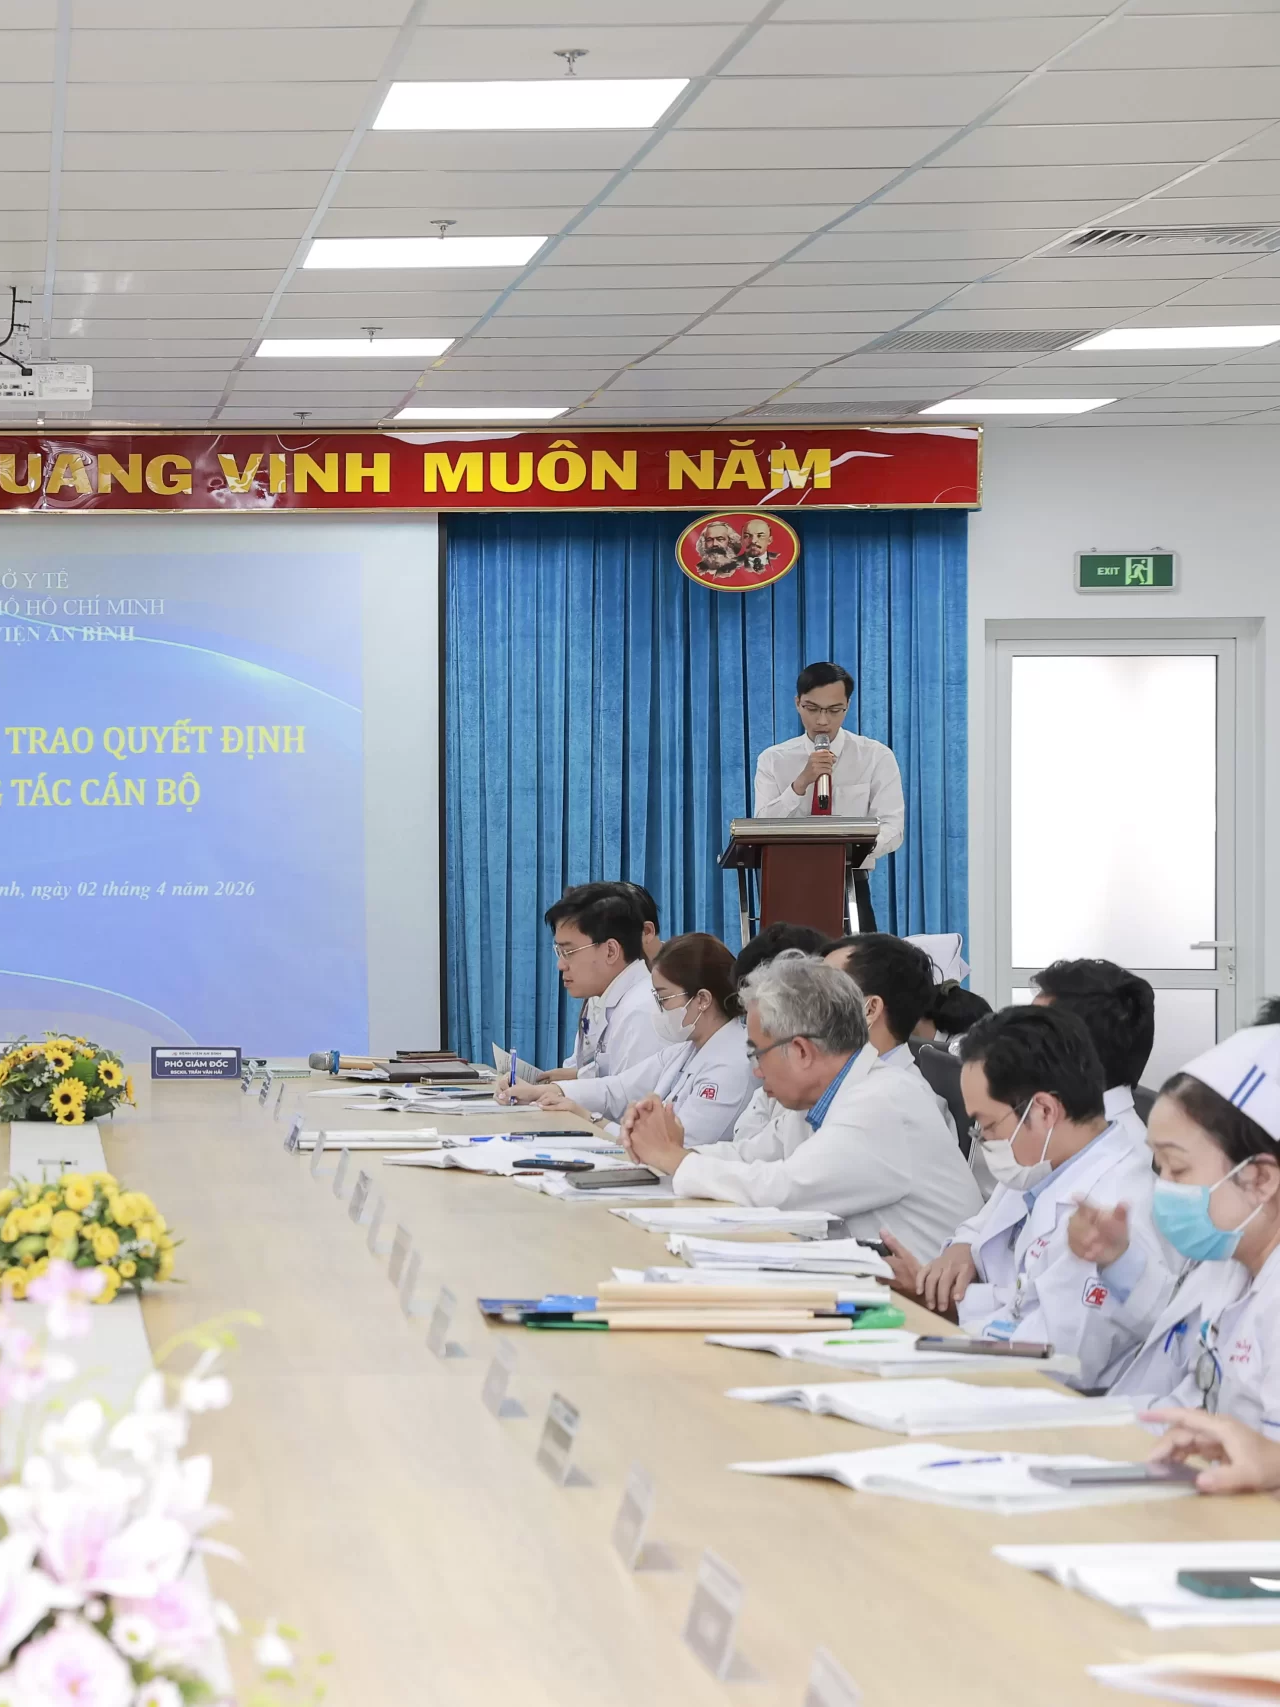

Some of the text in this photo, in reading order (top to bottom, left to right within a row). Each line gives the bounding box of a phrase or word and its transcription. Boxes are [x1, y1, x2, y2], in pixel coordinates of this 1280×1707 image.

[218, 453, 391, 494] VINH
[423, 439, 637, 493] MUÔN
[668, 439, 831, 490] NĂM
[22, 573, 38, 589] Y
[43, 568, 69, 589] TẾ
[1097, 567, 1120, 576] EXIT
[26, 595, 57, 616] HỒ
[63, 595, 100, 616] CHÍ
[106, 599, 165, 616] MINH
[45, 626, 75, 643] AN
[82, 621, 135, 642] BÌNH
[5, 726, 94, 754] TRAO
[103, 718, 213, 760] QUYẾT
[220, 725, 306, 760] ĐỊNH
[10, 772, 72, 806] TÁC
[80, 772, 147, 806] CÁN
[156, 771, 201, 812] BỘ
[31, 880, 72, 900] ngày
[77, 882, 97, 896] 02
[102, 881, 151, 900] tháng
[156, 881, 167, 896] 4
[171, 884, 209, 896] năm
[214, 881, 255, 896] 2026
[164, 1059, 228, 1068] PHÓ GIÁM ĐỐC
